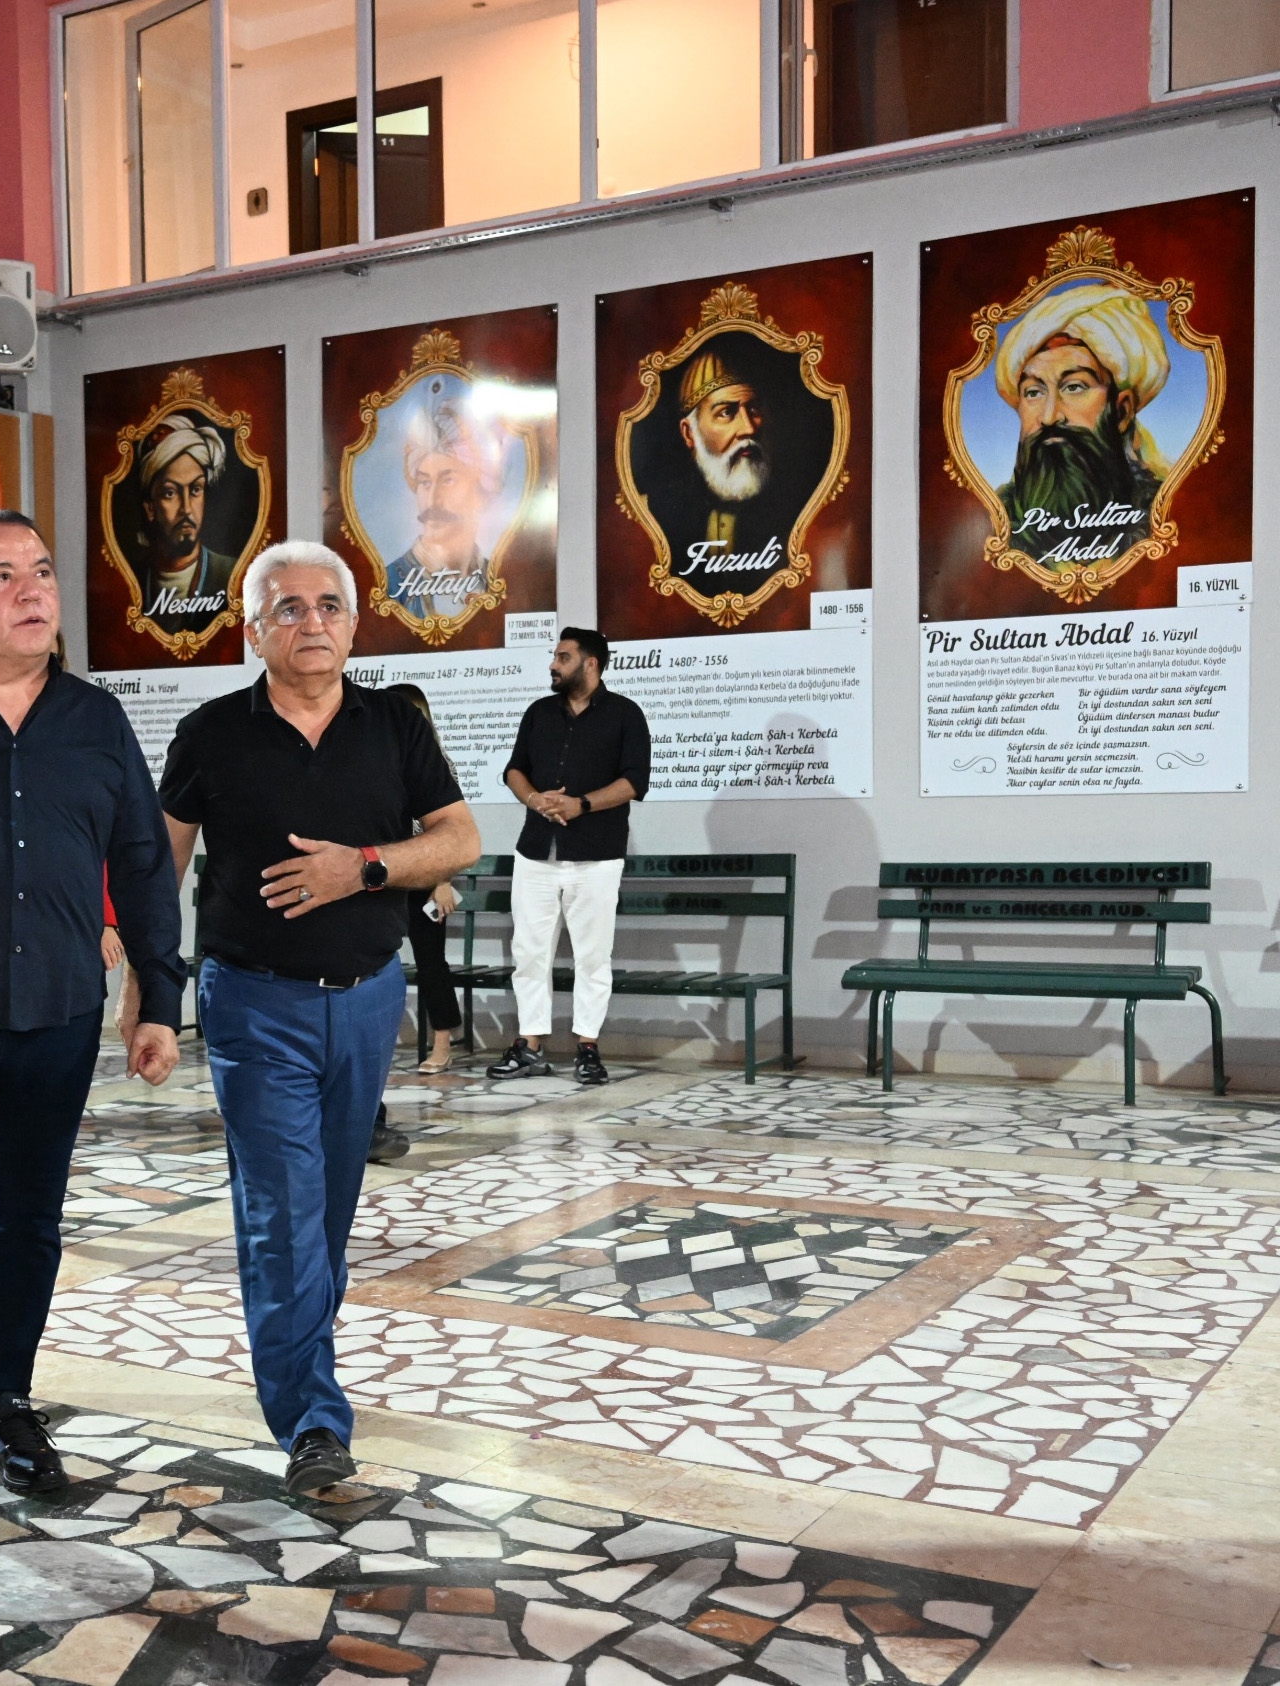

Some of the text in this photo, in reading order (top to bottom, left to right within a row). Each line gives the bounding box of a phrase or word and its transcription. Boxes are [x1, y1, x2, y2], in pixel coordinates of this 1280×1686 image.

[381, 138, 395, 146] 11
[1012, 501, 1145, 534] Pir Sultan
[1037, 533, 1124, 564] Abdal
[1189, 579, 1239, 593] 16. YÜZYIL
[819, 604, 864, 615] 1480 1556
[515, 620, 539, 629] TEMMUZ
[540, 619, 555, 628] 1487
[519, 631, 535, 640] MAYIS
[538, 631, 551, 639] 1524
[926, 621, 1199, 654] Pir Sultan Abdal 16. Yüzyıl
[604, 649, 728, 671] Fuzuli 1480? 1556
[347, 664, 522, 689] atayi 17 Temmuz 1487 23 Mayıs 1524
[1078, 689, 1092, 697] Bir
[1094, 688, 1129, 699] öğüdüm
[1132, 687, 1158, 695] vardır
[1185, 685, 1227, 696] söyleyem
[1078, 701, 1088, 709] En
[1091, 700, 1101, 712] iyi
[1104, 700, 1149, 709] dostundan
[1152, 699, 1175, 707] sakın
[1195, 697, 1213, 705] seni
[1078, 709, 1220, 725] Öğüdüm dinlersen manası budur
[928, 730, 942, 739] Her
[955, 730, 973, 738] oldu
[988, 728, 1023, 737] dilimden
[1027, 728, 1048, 736] oldu.
[1078, 722, 1215, 737] En iyi dostundan sakın sen seni.
